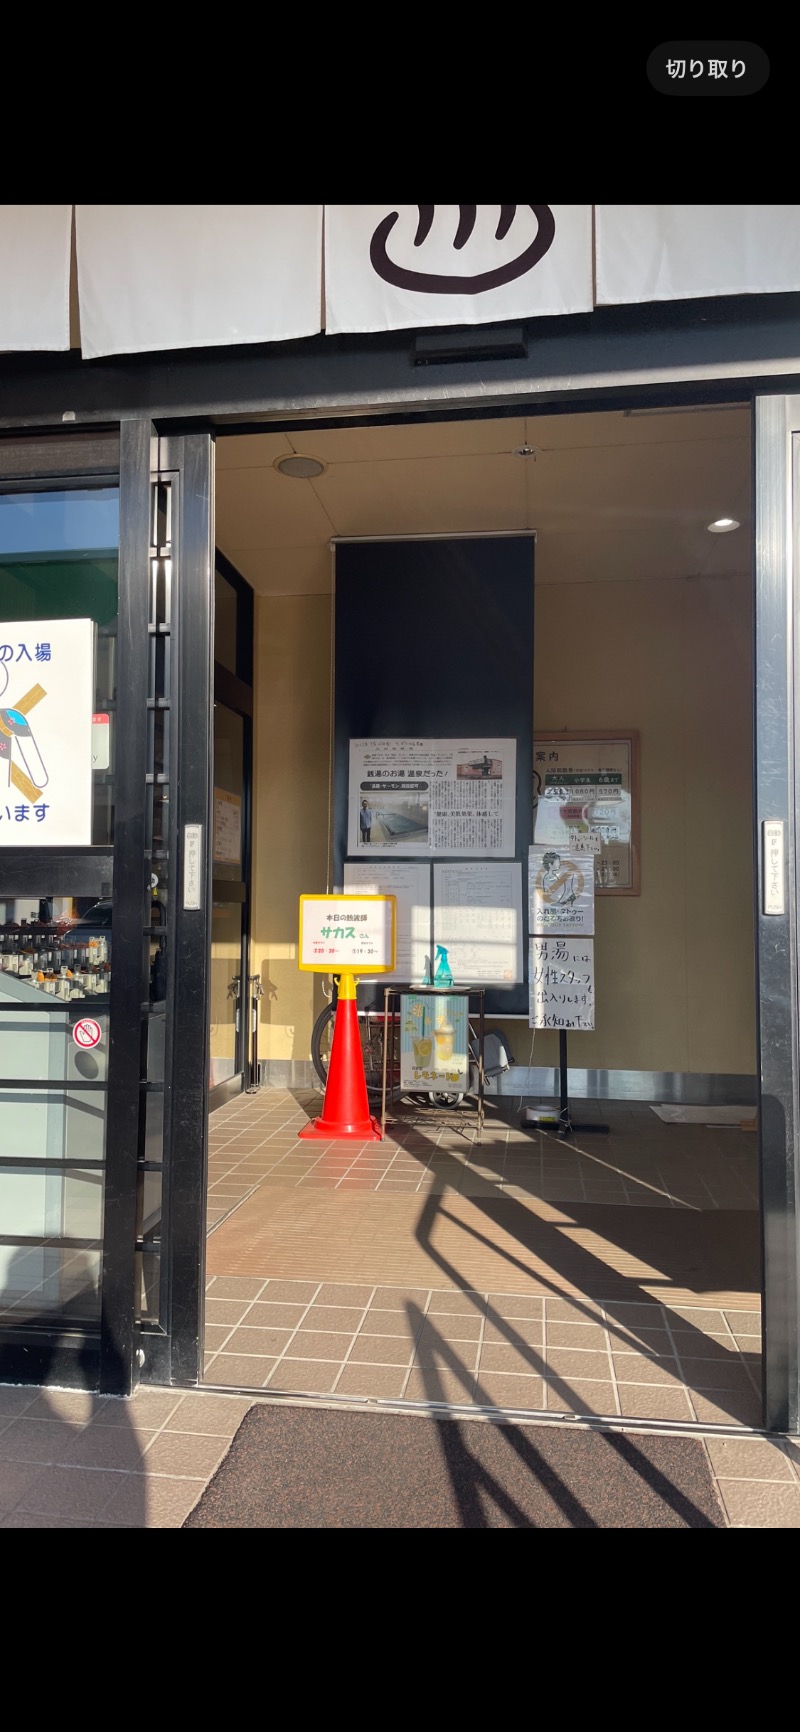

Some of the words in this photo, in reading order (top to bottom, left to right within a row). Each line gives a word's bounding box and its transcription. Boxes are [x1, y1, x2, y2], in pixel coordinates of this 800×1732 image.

[0, 643, 52, 662] の入場
[770, 849, 779, 896] 押して下さい
[320, 926, 356, 939] サカス
